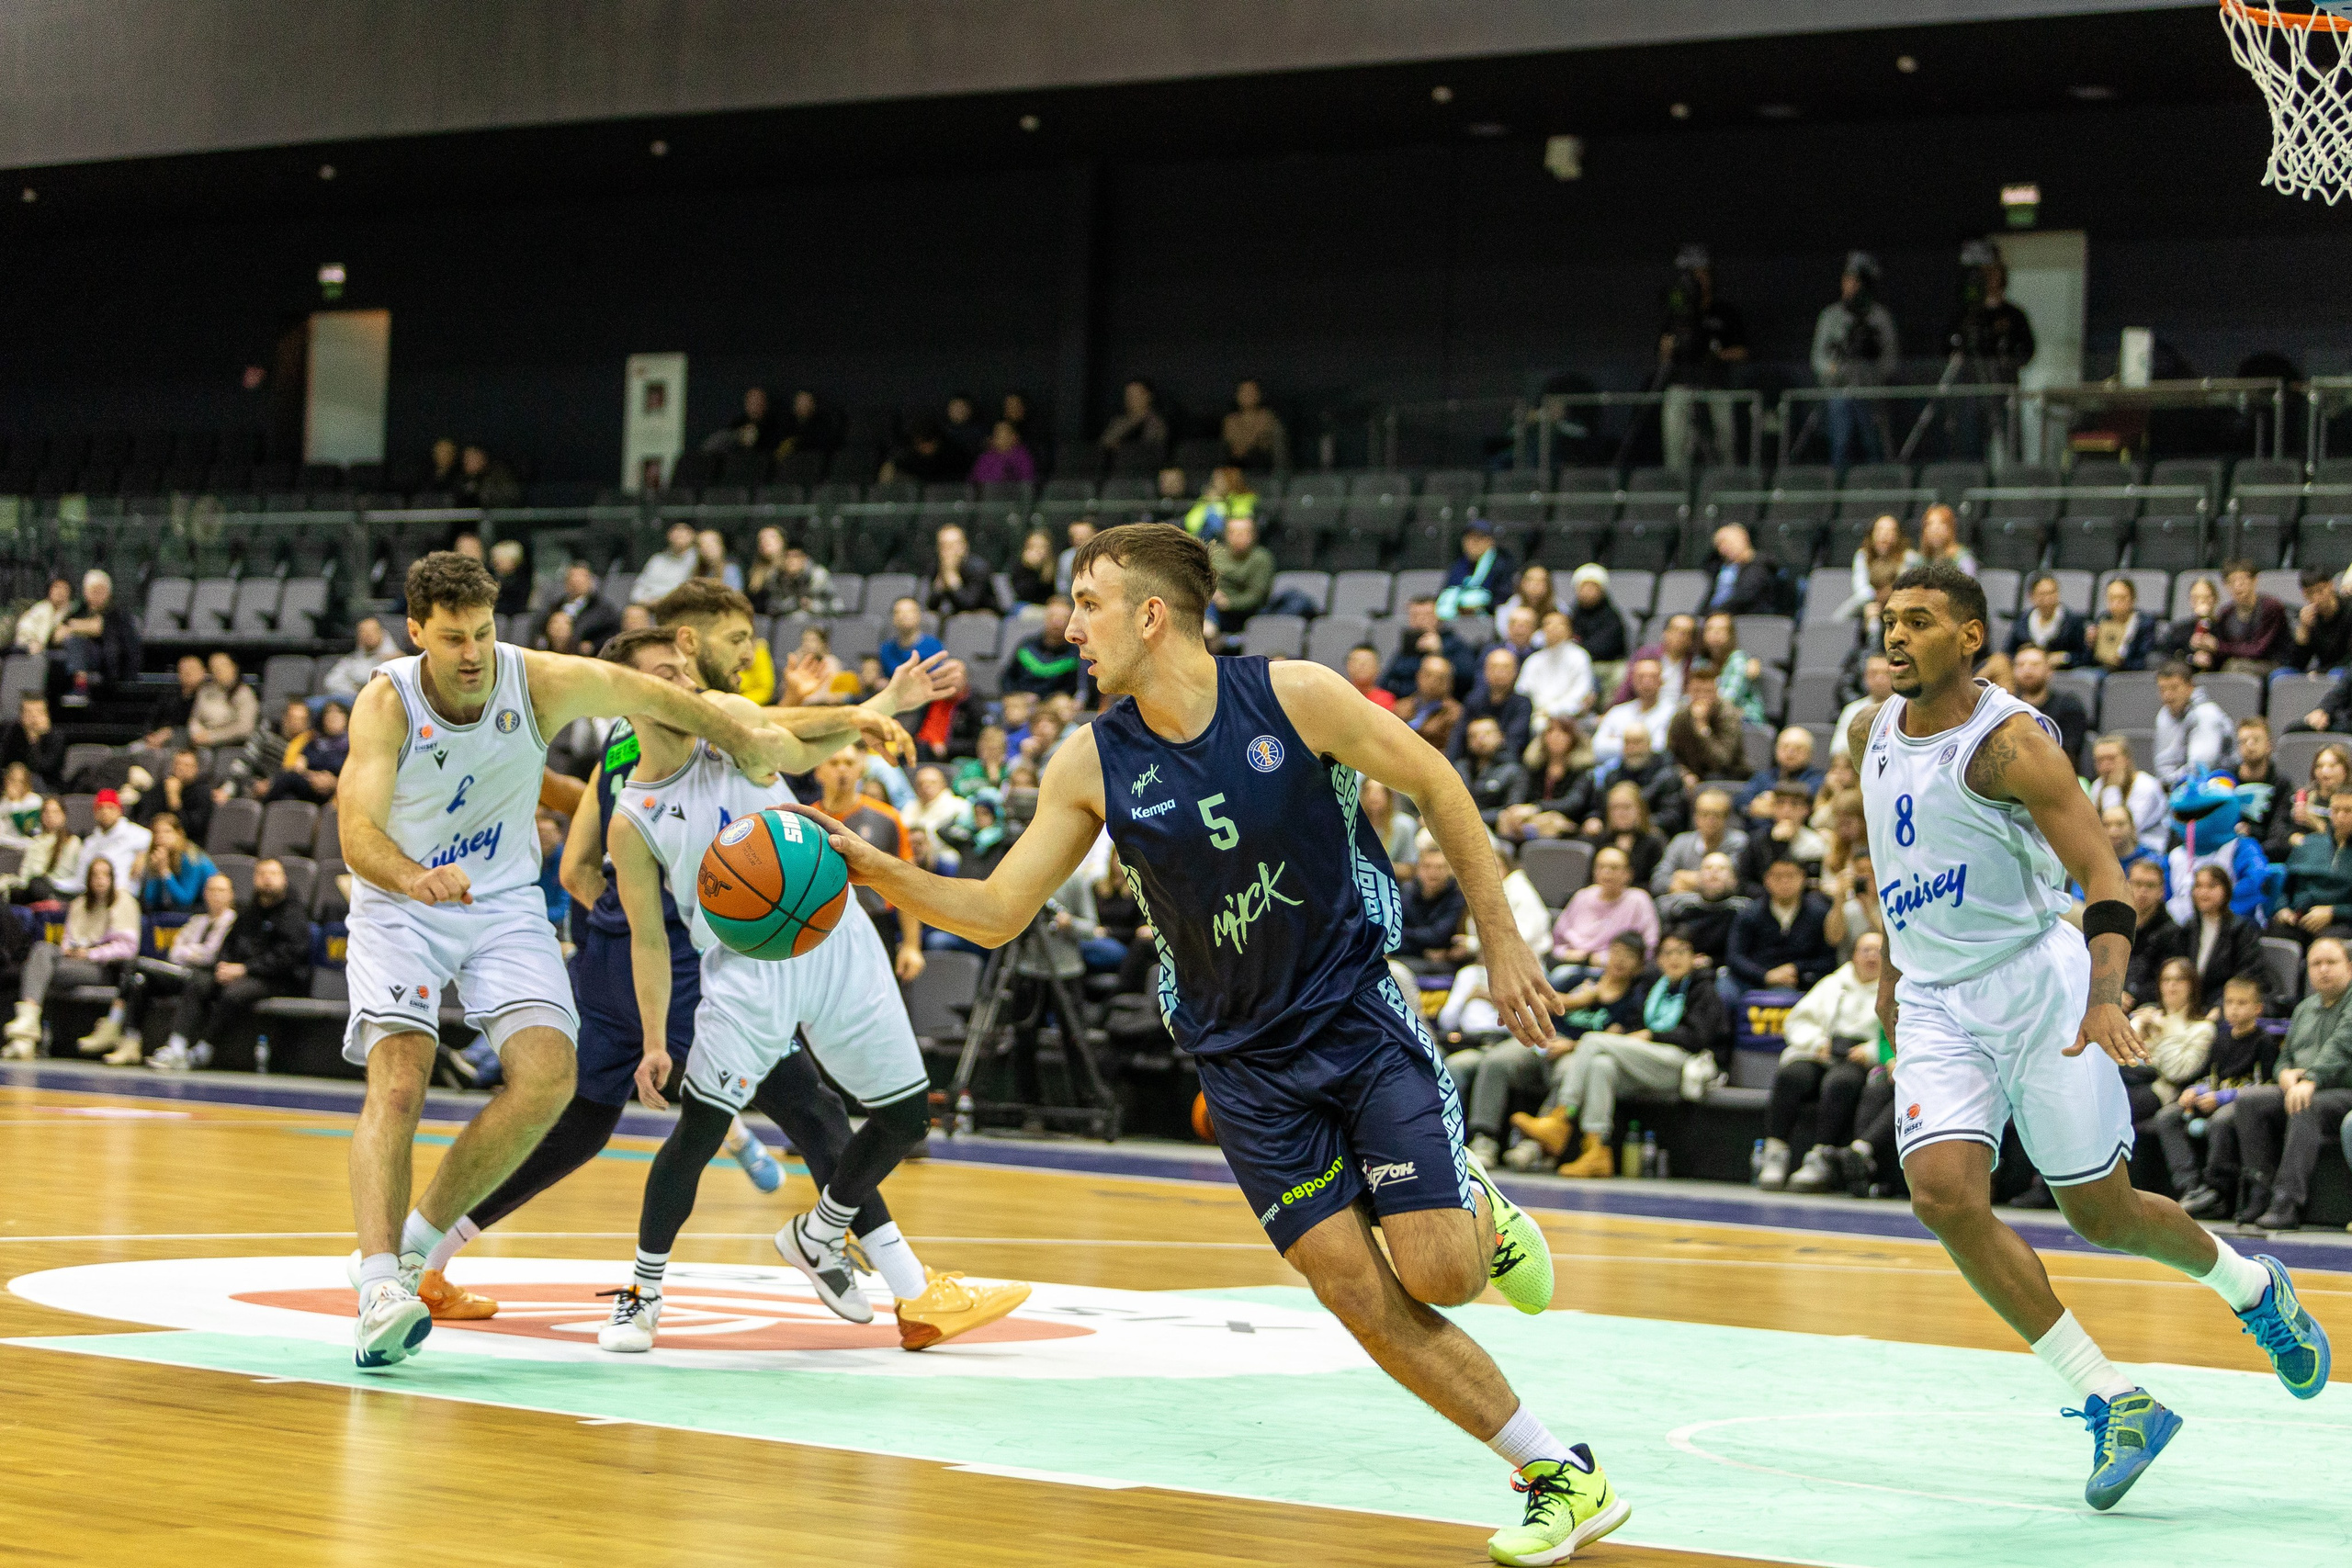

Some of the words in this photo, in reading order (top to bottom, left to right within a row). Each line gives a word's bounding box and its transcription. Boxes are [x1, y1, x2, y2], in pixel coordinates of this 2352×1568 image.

[775, 809, 804, 844] SIB
[1131, 798, 1176, 819] Kempa
[1197, 792, 1239, 851] 5
[1894, 794, 1916, 847] 8
[431, 821, 503, 869] nisey
[1880, 863, 1967, 931] Enisey
[1282, 1156, 1343, 1205] еврооп
[1260, 1202, 1280, 1227] empa
